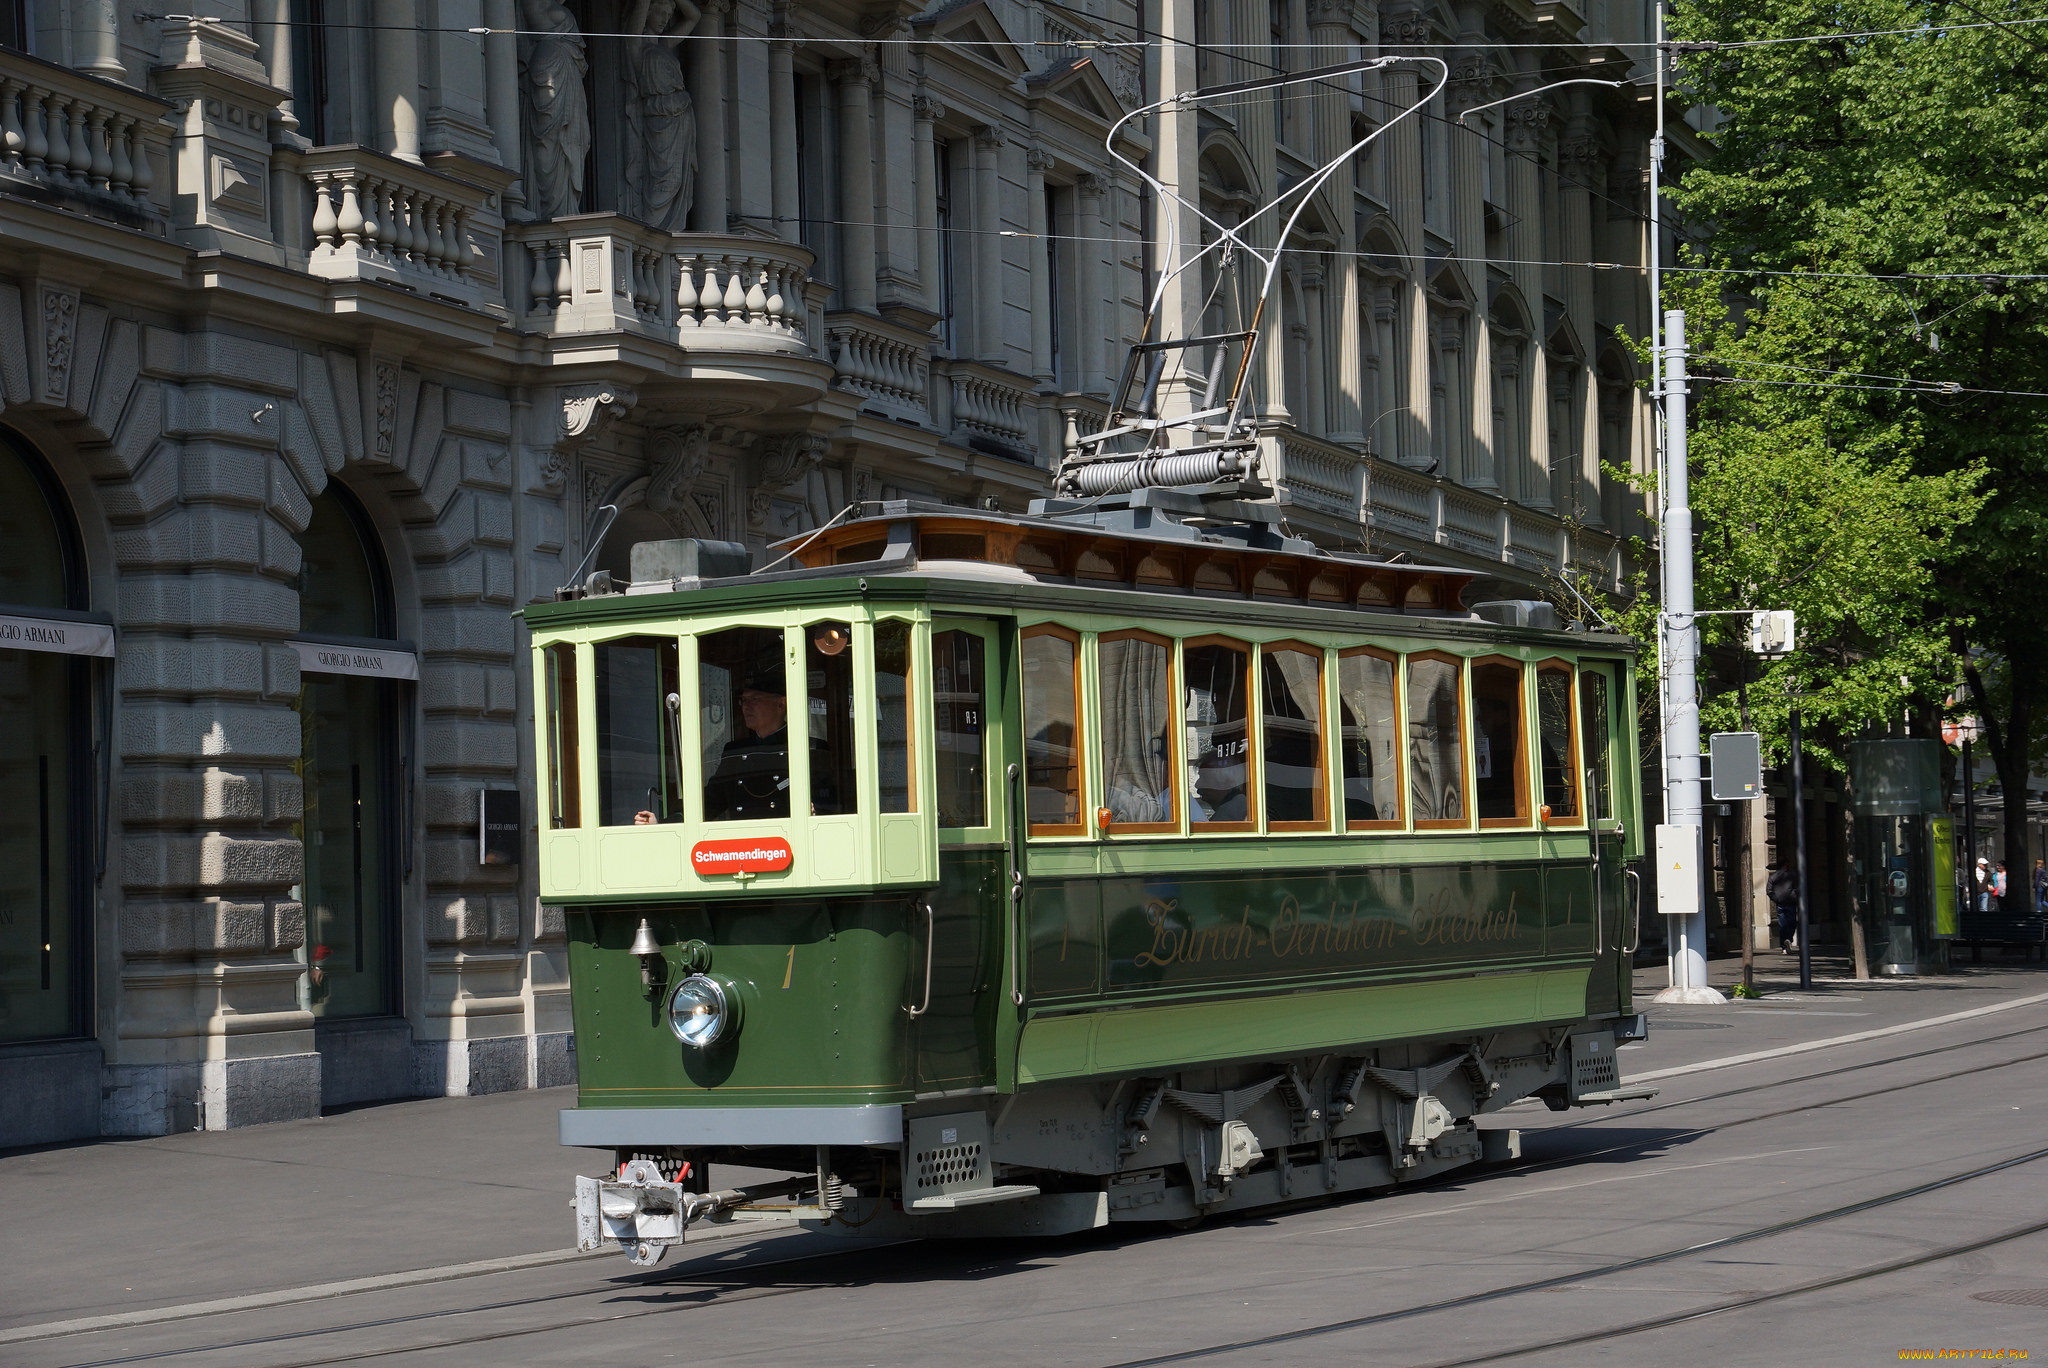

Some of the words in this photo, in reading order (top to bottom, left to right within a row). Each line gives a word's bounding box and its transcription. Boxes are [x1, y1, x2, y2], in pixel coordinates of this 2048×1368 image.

[0, 624, 21, 641] GIO
[24, 626, 66, 645] ARMANI
[318, 651, 351, 667] GIORGIO
[353, 654, 383, 670] ARMANI
[487, 823, 503, 831] GIORGIO
[503, 823, 518, 831] ARMANI
[695, 848, 787, 863] Schwamendingen
[781, 945, 796, 990] 1
